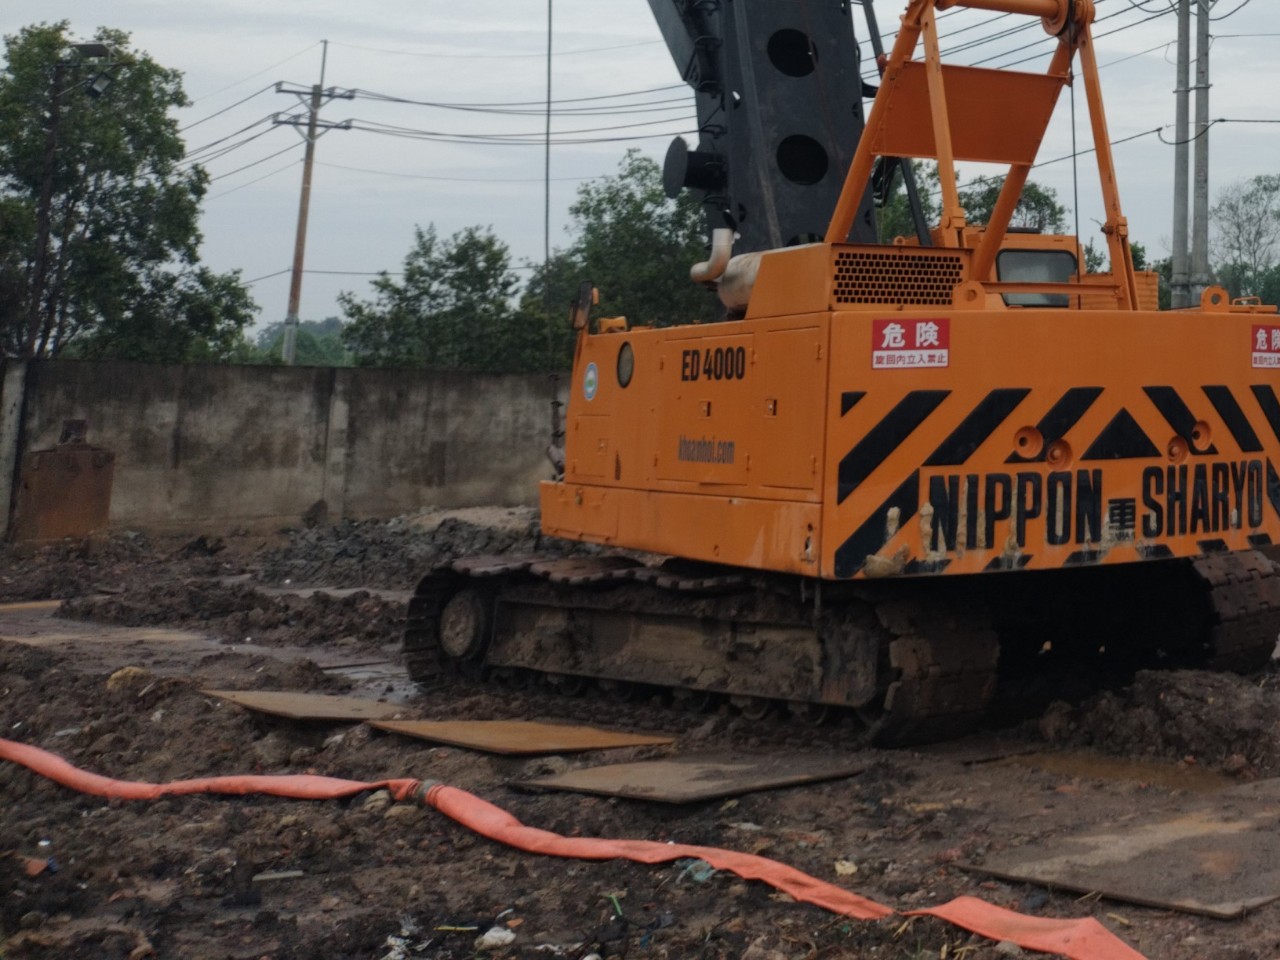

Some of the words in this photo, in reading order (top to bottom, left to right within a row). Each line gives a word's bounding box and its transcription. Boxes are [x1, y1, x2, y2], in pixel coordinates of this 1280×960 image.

[681, 349, 700, 381] ED
[703, 346, 746, 381] 4000
[929, 468, 1102, 551] NIPPON
[1142, 459, 1264, 539] SHARYO
